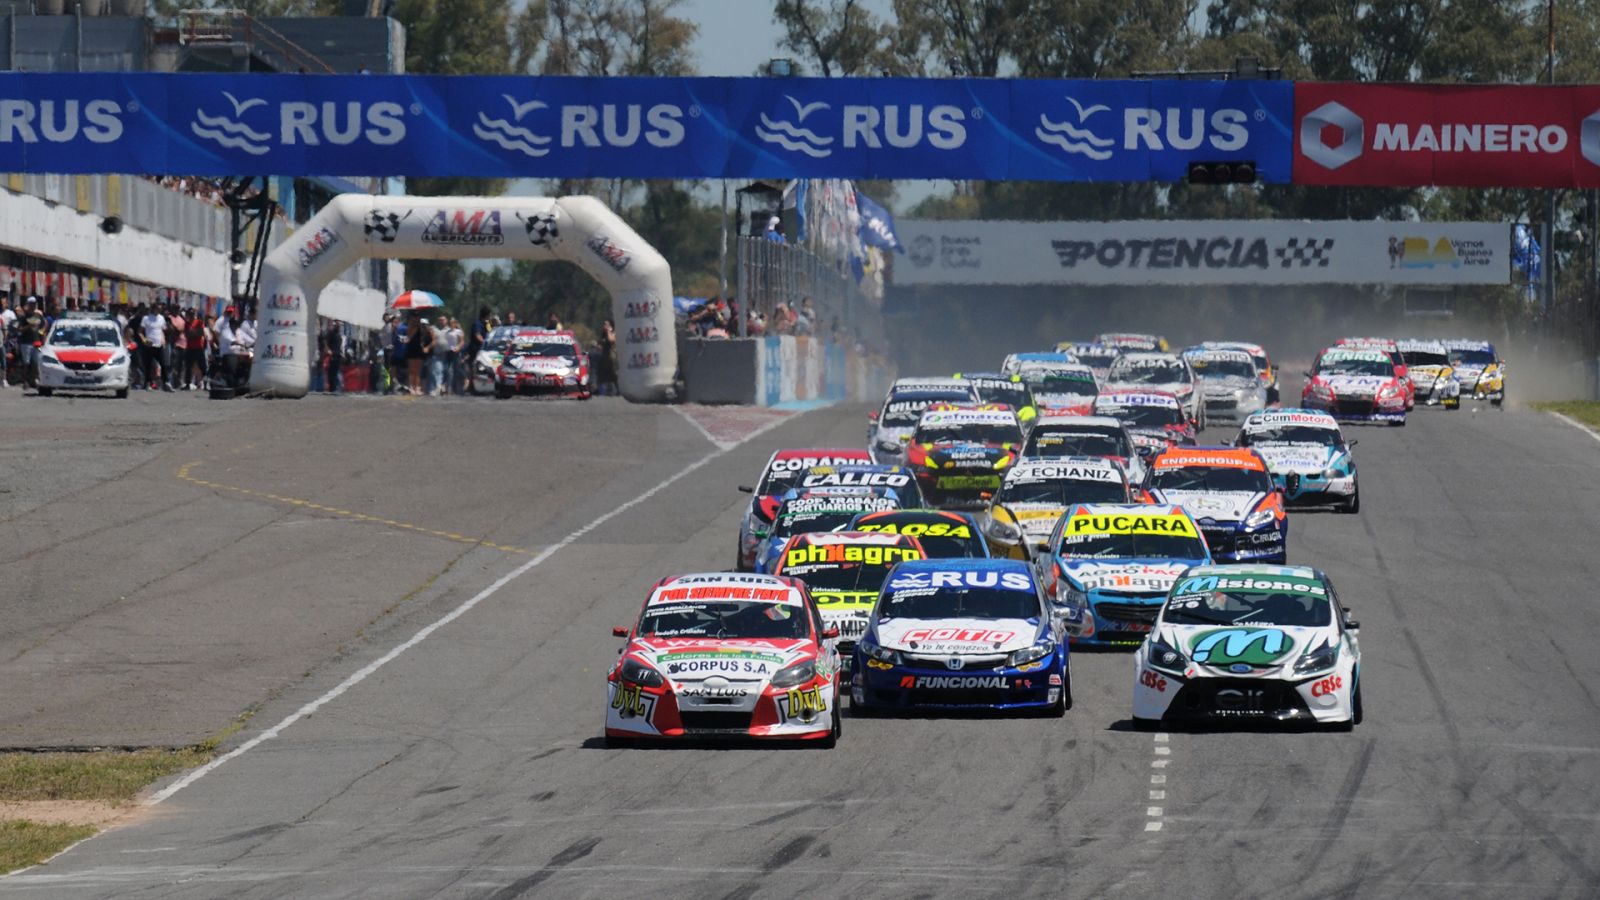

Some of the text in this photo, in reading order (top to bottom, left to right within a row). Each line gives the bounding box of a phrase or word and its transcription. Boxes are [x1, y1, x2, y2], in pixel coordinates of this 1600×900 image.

[0, 100, 123, 143] RUS
[281, 102, 406, 145] RUS
[561, 104, 686, 147] RUS
[843, 105, 966, 149] RUS
[1124, 108, 1248, 151] RUS
[1373, 123, 1568, 152] MAINERO
[424, 210, 501, 234] AMA
[1052, 237, 1268, 268] POTENCIA
[1161, 457, 1244, 465] ENDOGROUP
[803, 473, 909, 487] CALICO
[1031, 467, 1111, 479] ECHANIZ
[787, 502, 862, 514] PORTUARIOS
[829, 498, 897, 507] TRABAJOS
[1074, 517, 1187, 532] PUCARA
[788, 544, 921, 566] philagro
[931, 572, 1031, 590] RUS
[1083, 576, 1175, 592] philagr
[1177, 576, 1325, 595] Misiones
[659, 588, 689, 601] POR
[689, 587, 753, 601] SIEMPRE
[901, 628, 1014, 644] COTO
[679, 661, 770, 675] CORPUS S.A.
[916, 676, 1010, 689] FUNCIONAL
[682, 688, 748, 697] SAN LUIS
